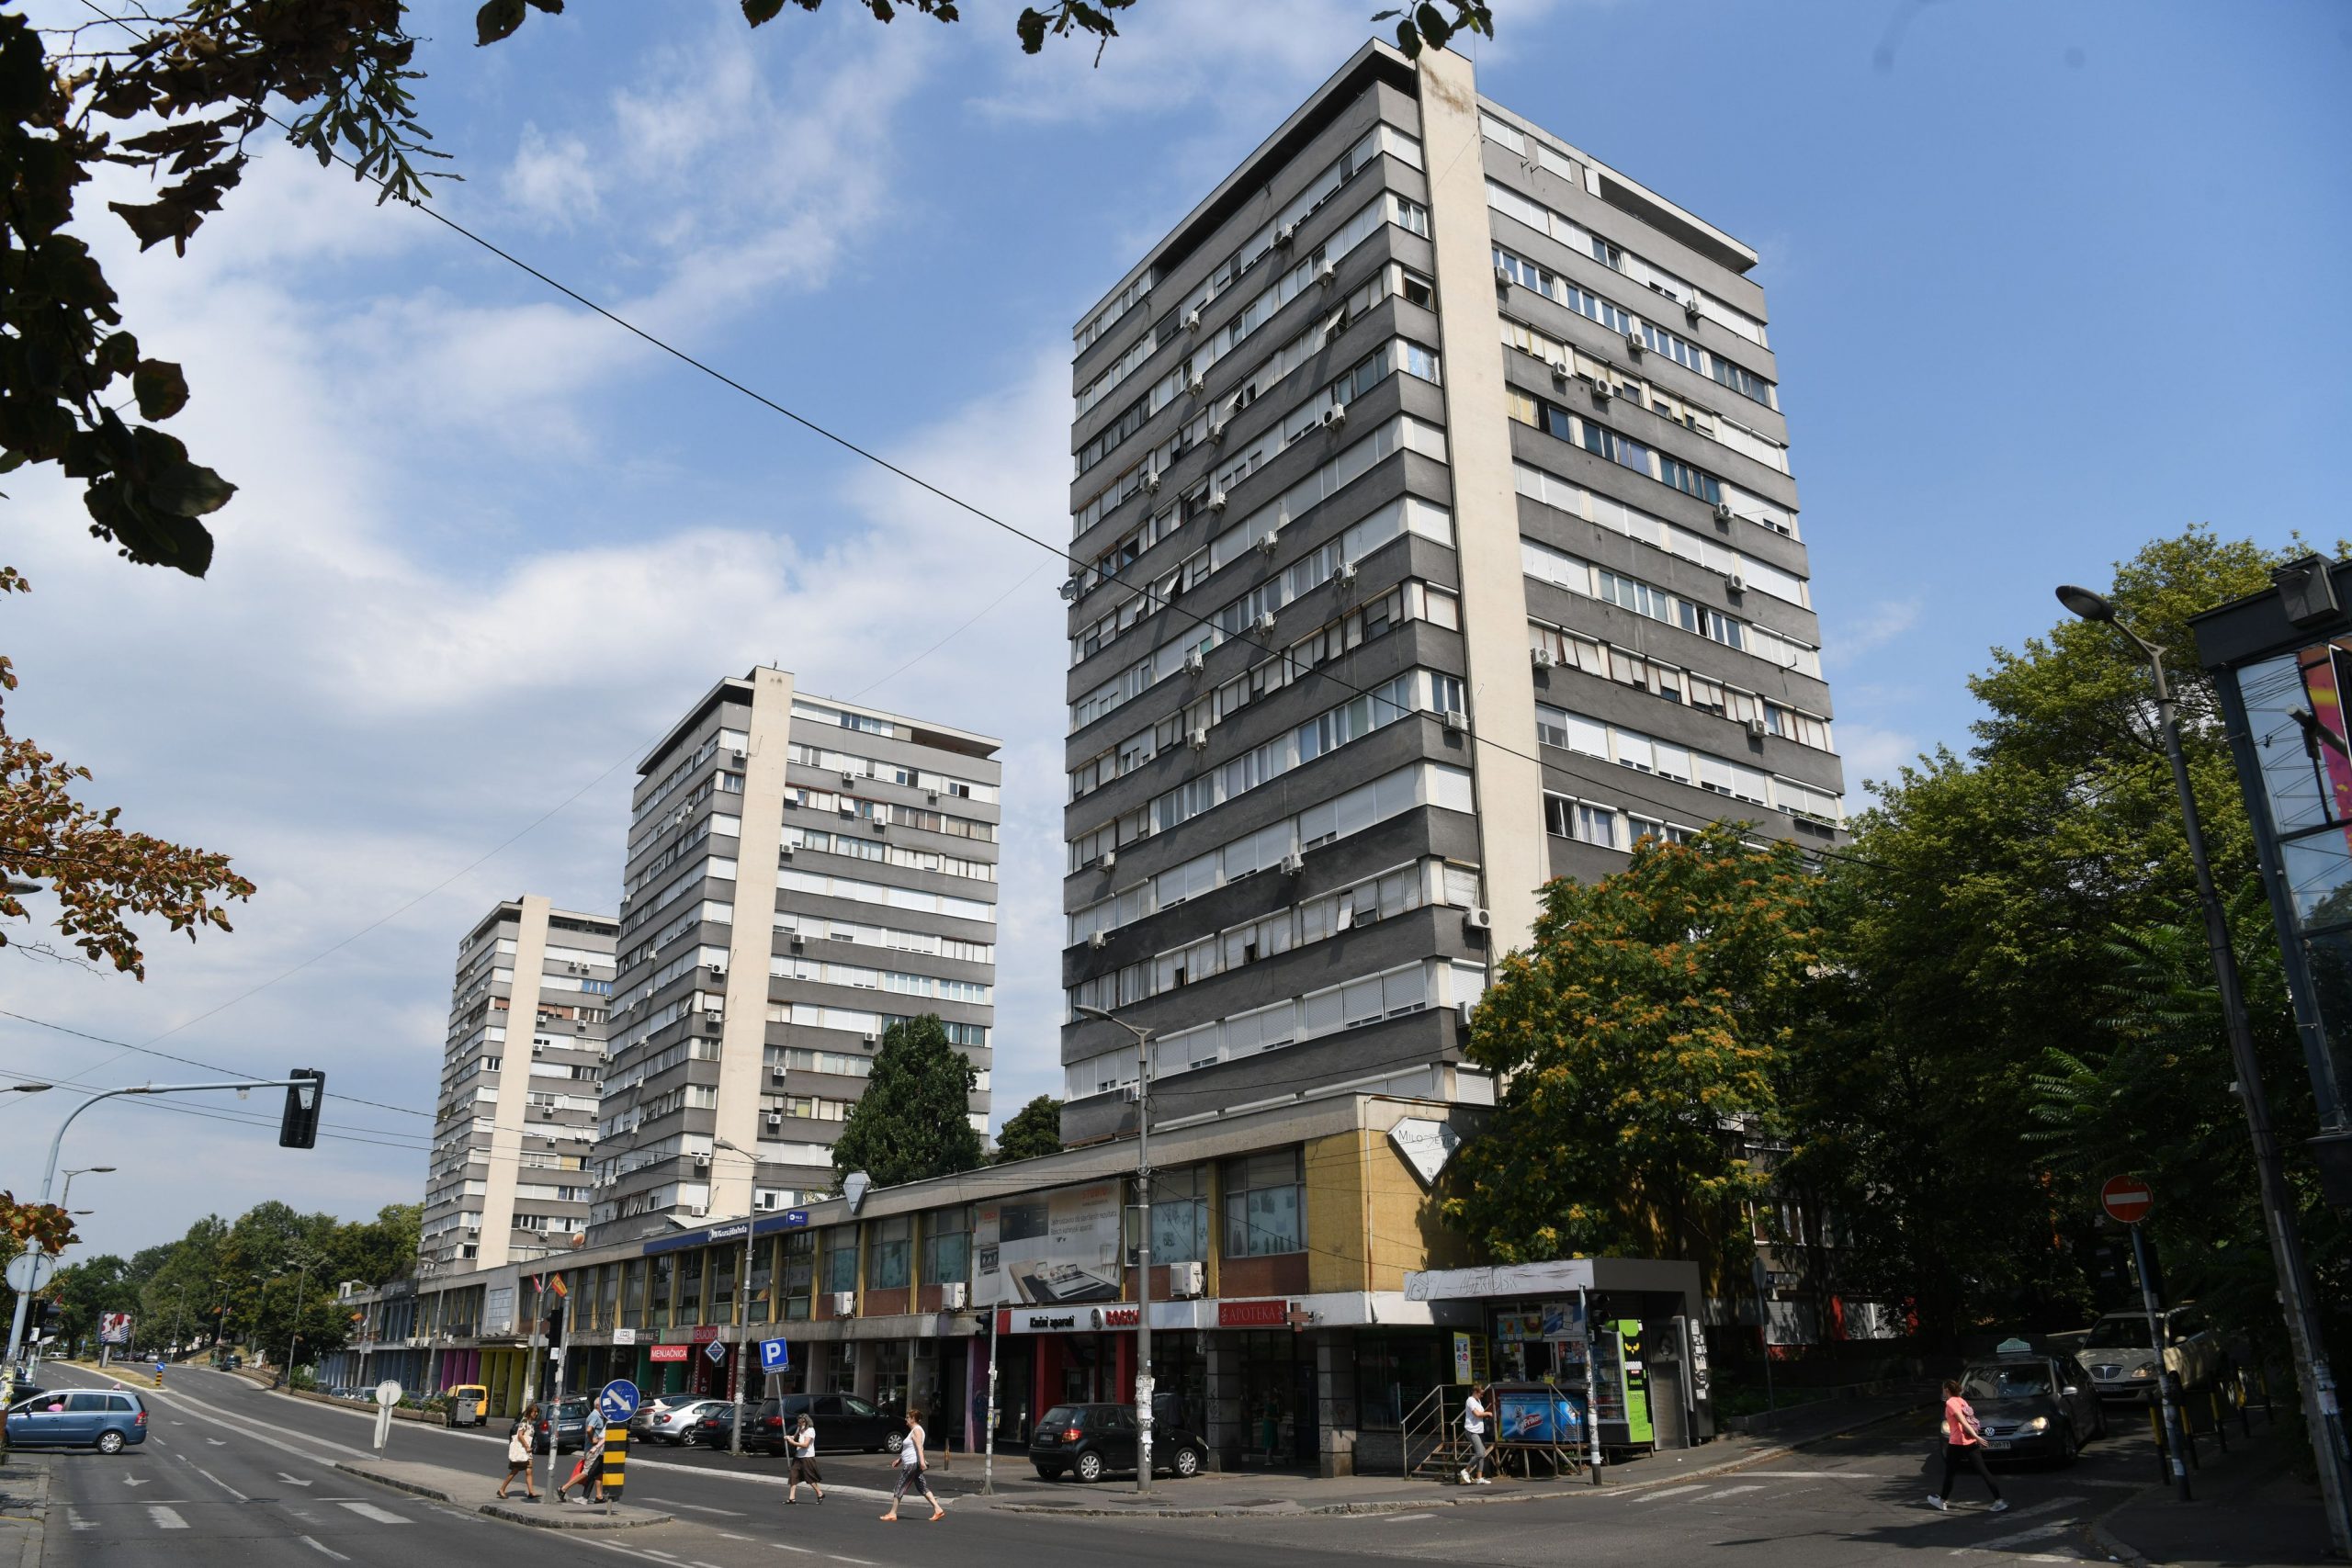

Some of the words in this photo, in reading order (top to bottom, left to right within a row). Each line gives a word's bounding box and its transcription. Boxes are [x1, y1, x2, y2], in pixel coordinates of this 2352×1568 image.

[1105, 1309, 1139, 1326] BOSCH
[1230, 1306, 1275, 1322] APOTEKA
[1049, 1315, 1075, 1330] aparati
[650, 1348, 687, 1359] MENJAČNICA
[765, 1342, 781, 1364] P
